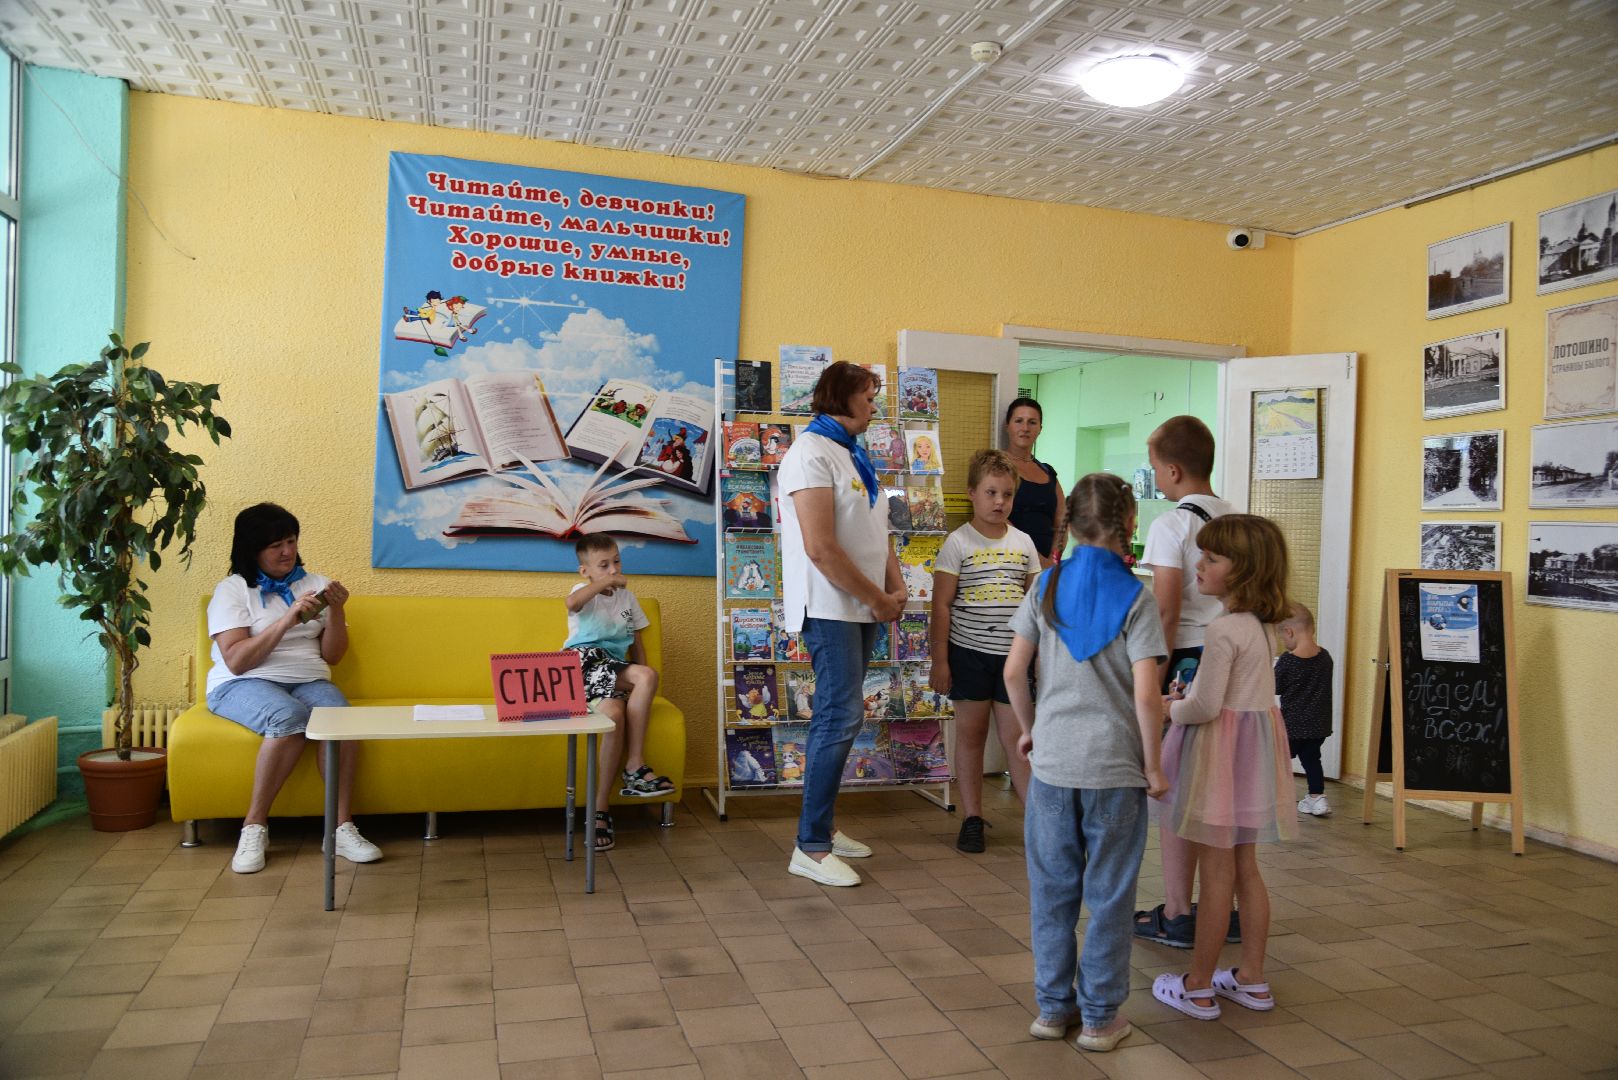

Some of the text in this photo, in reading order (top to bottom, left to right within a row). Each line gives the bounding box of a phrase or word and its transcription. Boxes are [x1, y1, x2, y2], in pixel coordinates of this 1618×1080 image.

[428, 171, 715, 220] Читайте, девчонки!
[407, 195, 731, 247] Читайте, мальчишки!
[447, 225, 691, 270] Хорошие, умные,
[452, 252, 686, 290] добрые книжки!
[1552, 337, 1609, 359] ЛОТОШИНО
[499, 665, 576, 705] СТАРТ
[1408, 666, 1497, 716] Ждём
